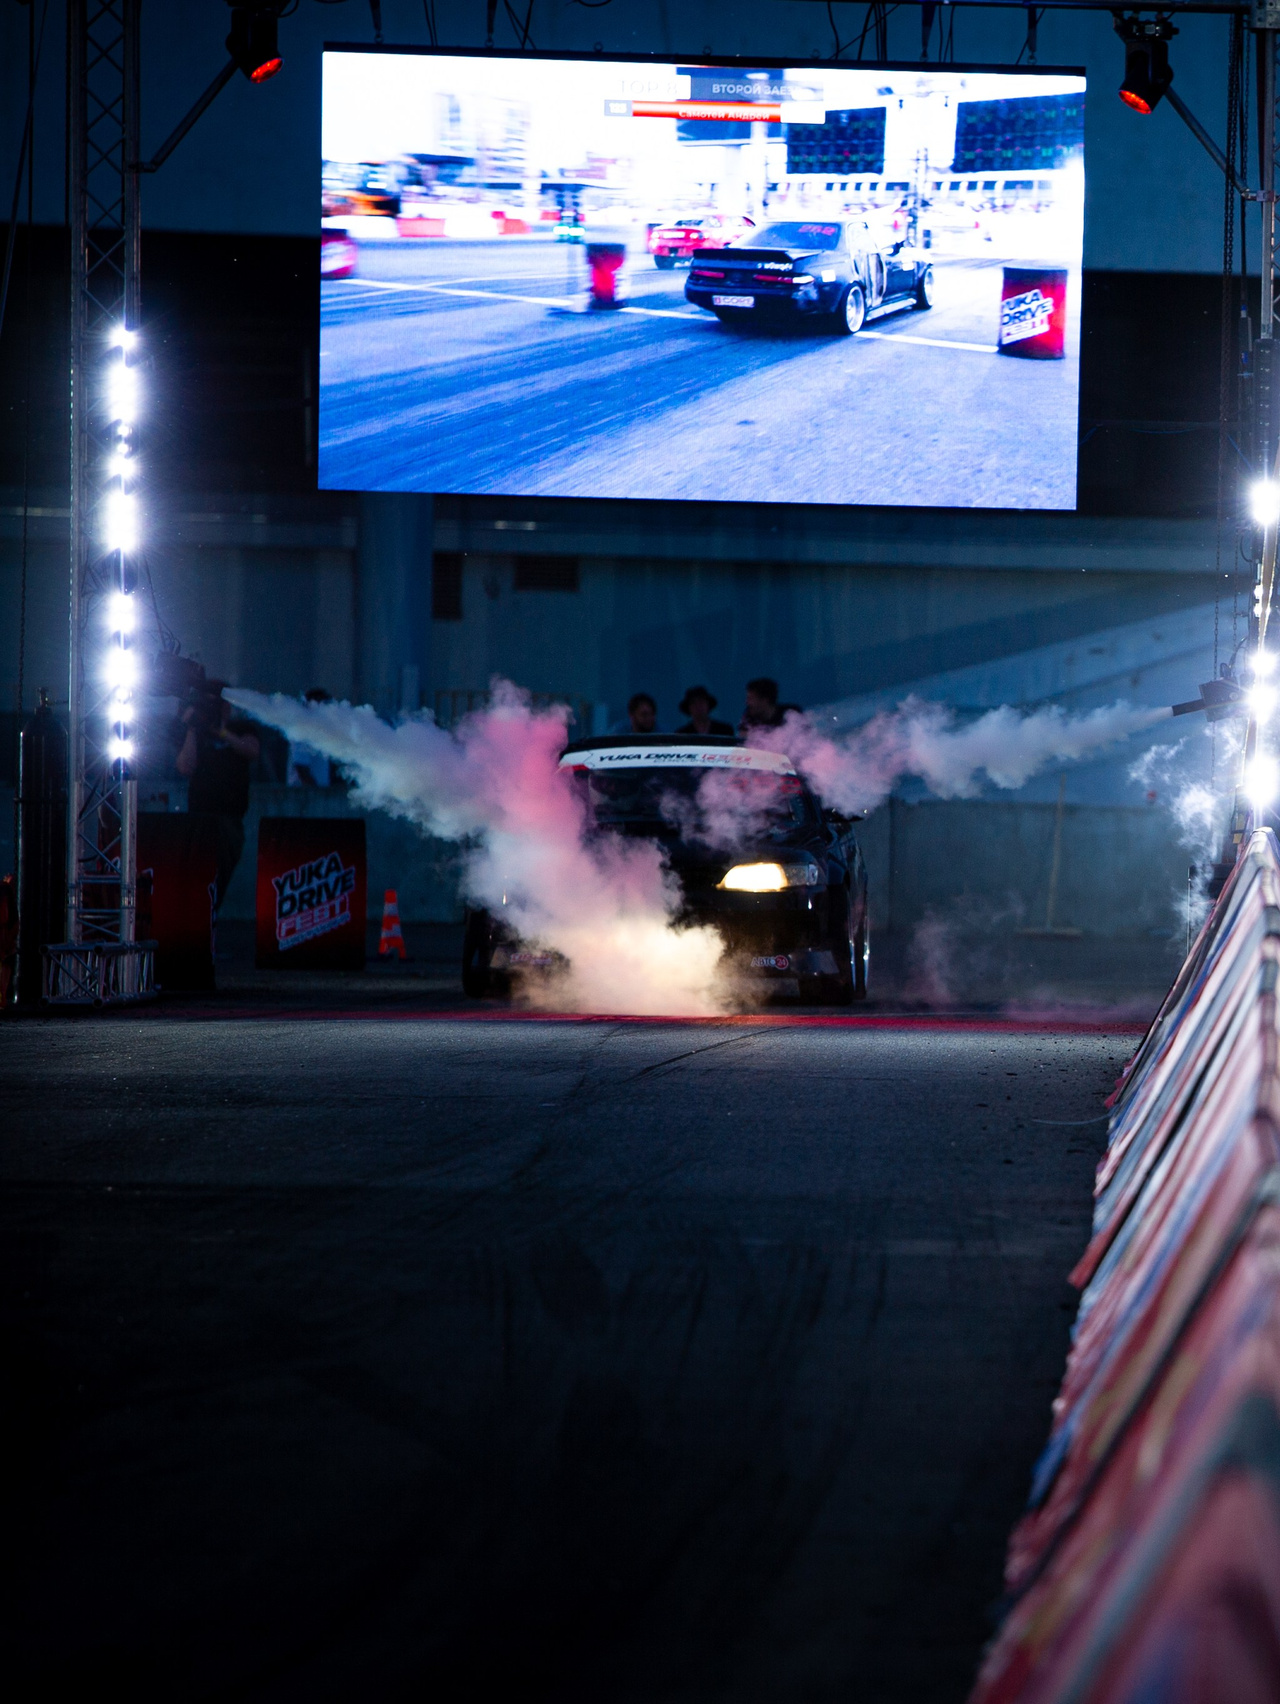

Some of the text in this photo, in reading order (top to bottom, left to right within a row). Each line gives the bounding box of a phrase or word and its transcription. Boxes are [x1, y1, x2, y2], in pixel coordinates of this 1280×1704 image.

[712, 82, 761, 95] ВТОРОЙ
[600, 753, 642, 762] YUKA
[274, 853, 342, 898] YUKA
[277, 868, 355, 919] DRIVE
[278, 894, 349, 938] FEST
